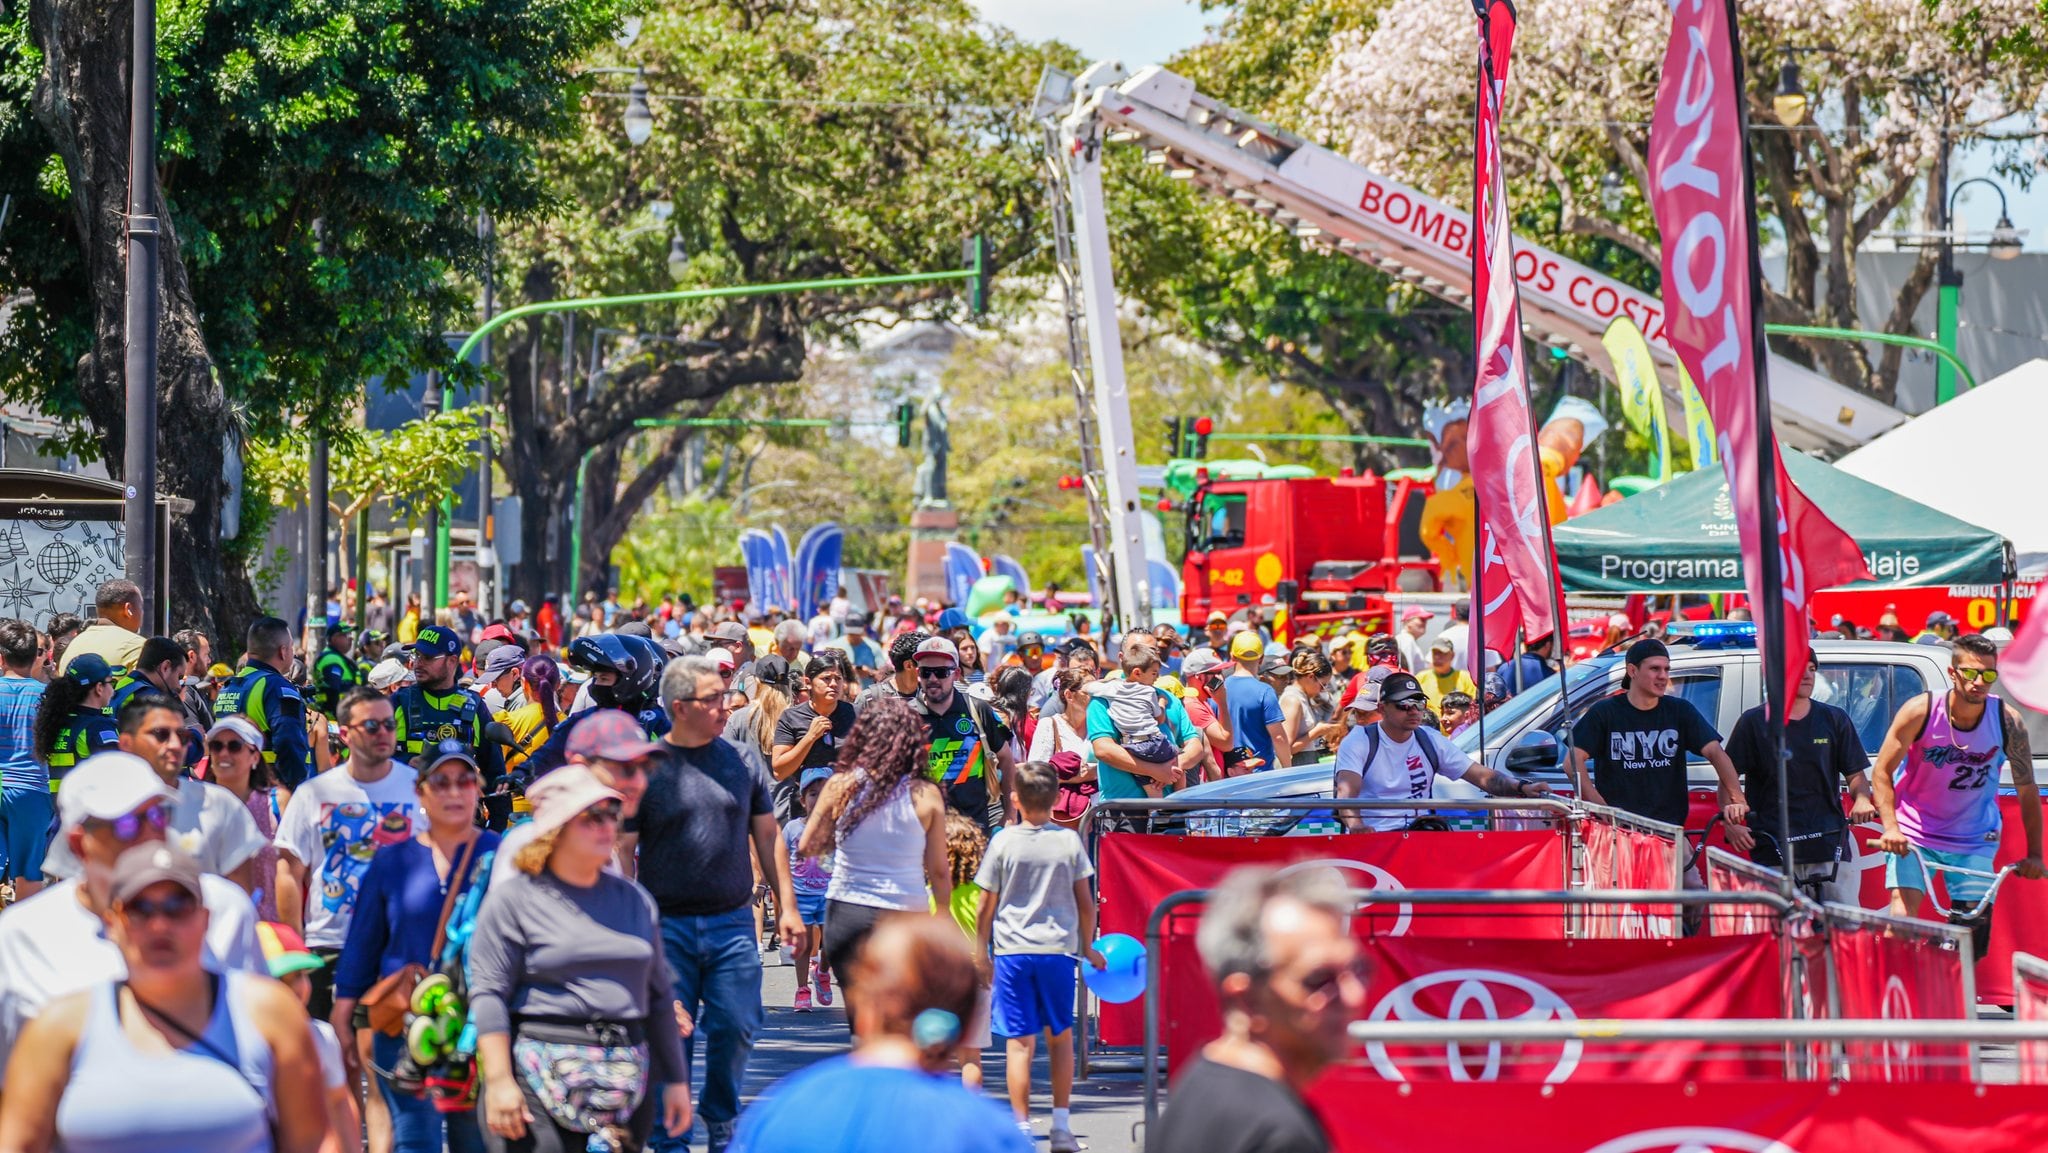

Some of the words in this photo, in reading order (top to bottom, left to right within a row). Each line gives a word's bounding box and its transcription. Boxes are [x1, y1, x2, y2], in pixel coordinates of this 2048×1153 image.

[1359, 180, 1558, 292] BOMBOS
[1601, 555, 1738, 584] Programa
[581, 640, 605, 656] POLICIA
[929, 749, 969, 760] INTER
[1610, 729, 1679, 760] NYC
[1623, 761, 1646, 770] New
[1648, 758, 1671, 768] York
[1948, 764, 1992, 791] 22
